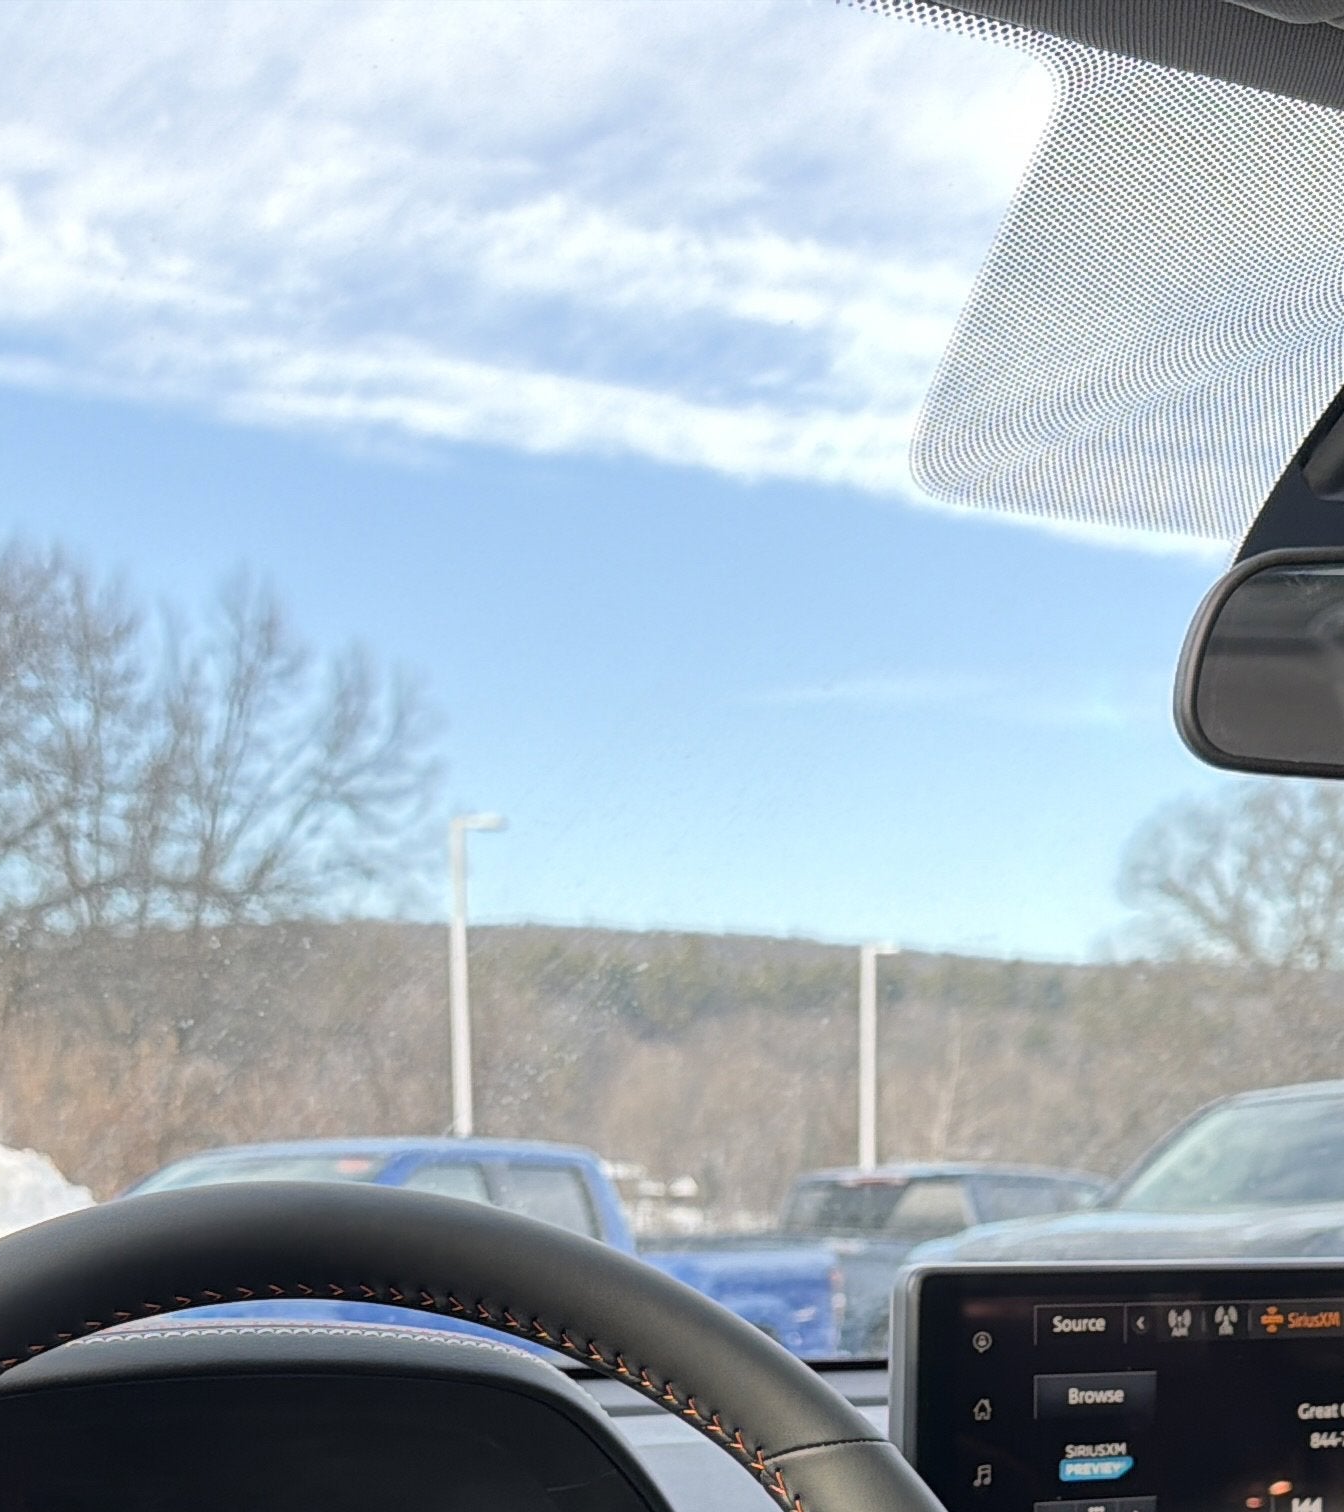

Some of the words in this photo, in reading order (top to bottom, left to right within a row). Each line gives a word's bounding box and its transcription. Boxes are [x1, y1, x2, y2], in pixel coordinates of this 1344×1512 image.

[1052, 1315, 1106, 1333] Source
[1287, 1312, 1341, 1329] SiriusXM
[1068, 1388, 1124, 1405] Browse
[1297, 1403, 1339, 1420] Great
